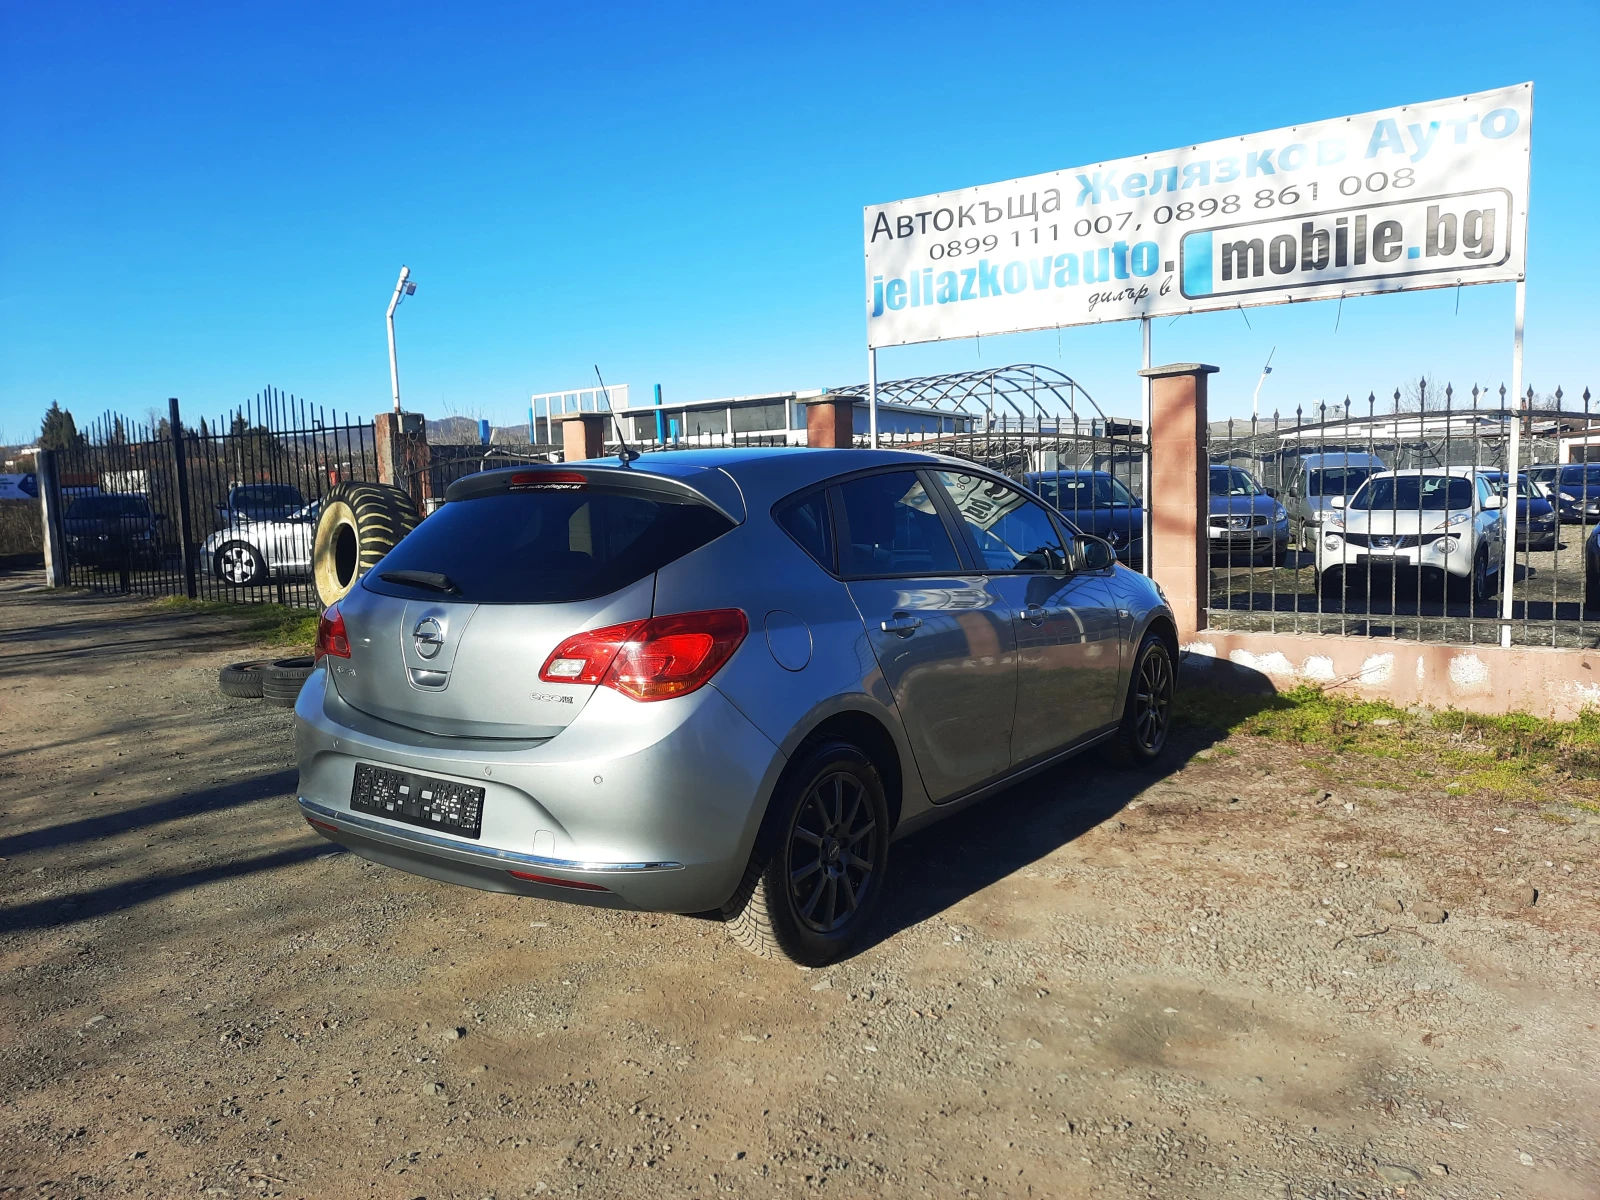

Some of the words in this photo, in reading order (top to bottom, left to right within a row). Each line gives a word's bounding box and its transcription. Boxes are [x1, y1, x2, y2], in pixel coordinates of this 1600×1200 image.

[870, 188, 1061, 243] Автокъща
[1074, 138, 1348, 208] Желязков
[1365, 107, 1521, 164] Ауто
[929, 234, 999, 260] 0899
[1010, 224, 1058, 247] 111
[1073, 212, 1142, 237] 007,
[1152, 194, 1242, 225] 0898
[1253, 182, 1319, 209] 861
[1338, 168, 1416, 196] 008
[1220, 204, 1496, 281] mobile.bg
